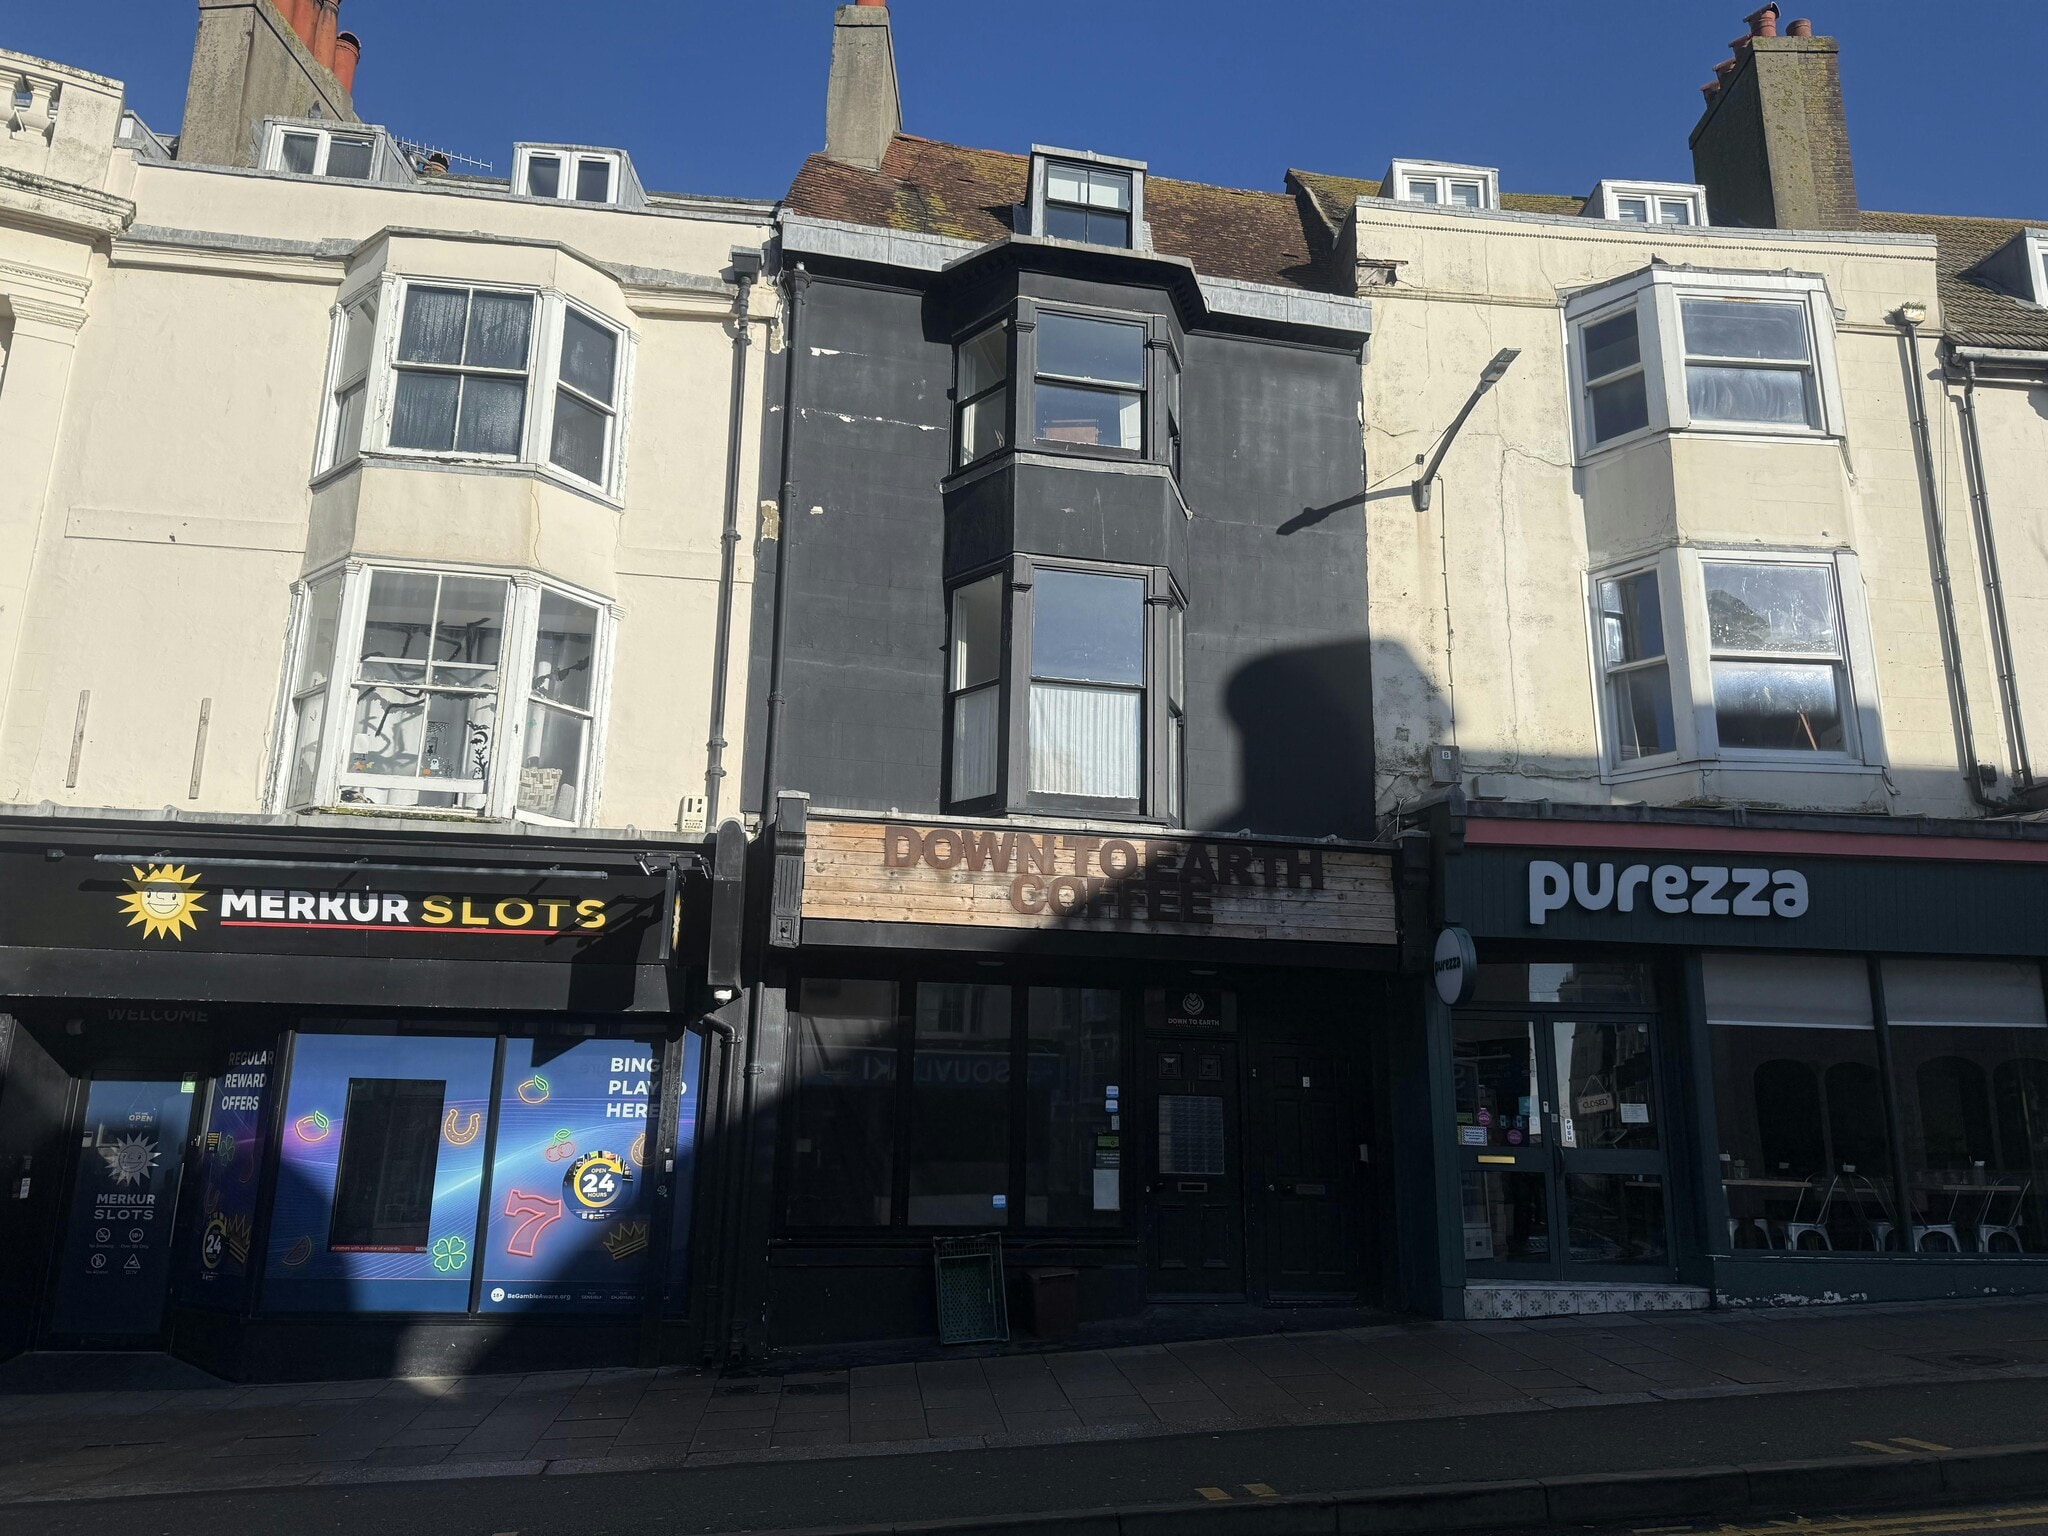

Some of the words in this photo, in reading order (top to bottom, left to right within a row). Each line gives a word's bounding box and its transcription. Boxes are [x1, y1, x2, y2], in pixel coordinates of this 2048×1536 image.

[884, 825, 1055, 874] DOWN
[1062, 835, 1138, 880] TO
[1144, 841, 1325, 890] EARTH
[1009, 874, 1214, 924] COFFEE
[1527, 859, 1810, 926] purezza
[219, 888, 410, 923] MERKUR
[420, 894, 608, 929] SLOTS
[1434, 956, 1462, 977] purezza
[107, 1008, 209, 1023] WELCOME
[227, 1050, 275, 1066] REGULAR
[610, 1057, 661, 1073] BING
[224, 1073, 268, 1088] REWARD
[608, 1080, 688, 1095] PLAY
[221, 1095, 260, 1111] OFFERS
[605, 1102, 661, 1118] HERE
[1582, 1098, 1608, 1109] CLOSED
[128, 1114, 154, 1122] OPEN
[582, 1173, 615, 1193] 24
[96, 1193, 156, 1205] MERKUR
[93, 1209, 155, 1220] SLOTS
[205, 1234, 222, 1254] 24
[507, 1292, 571, 1301] BeGambleAware.org
